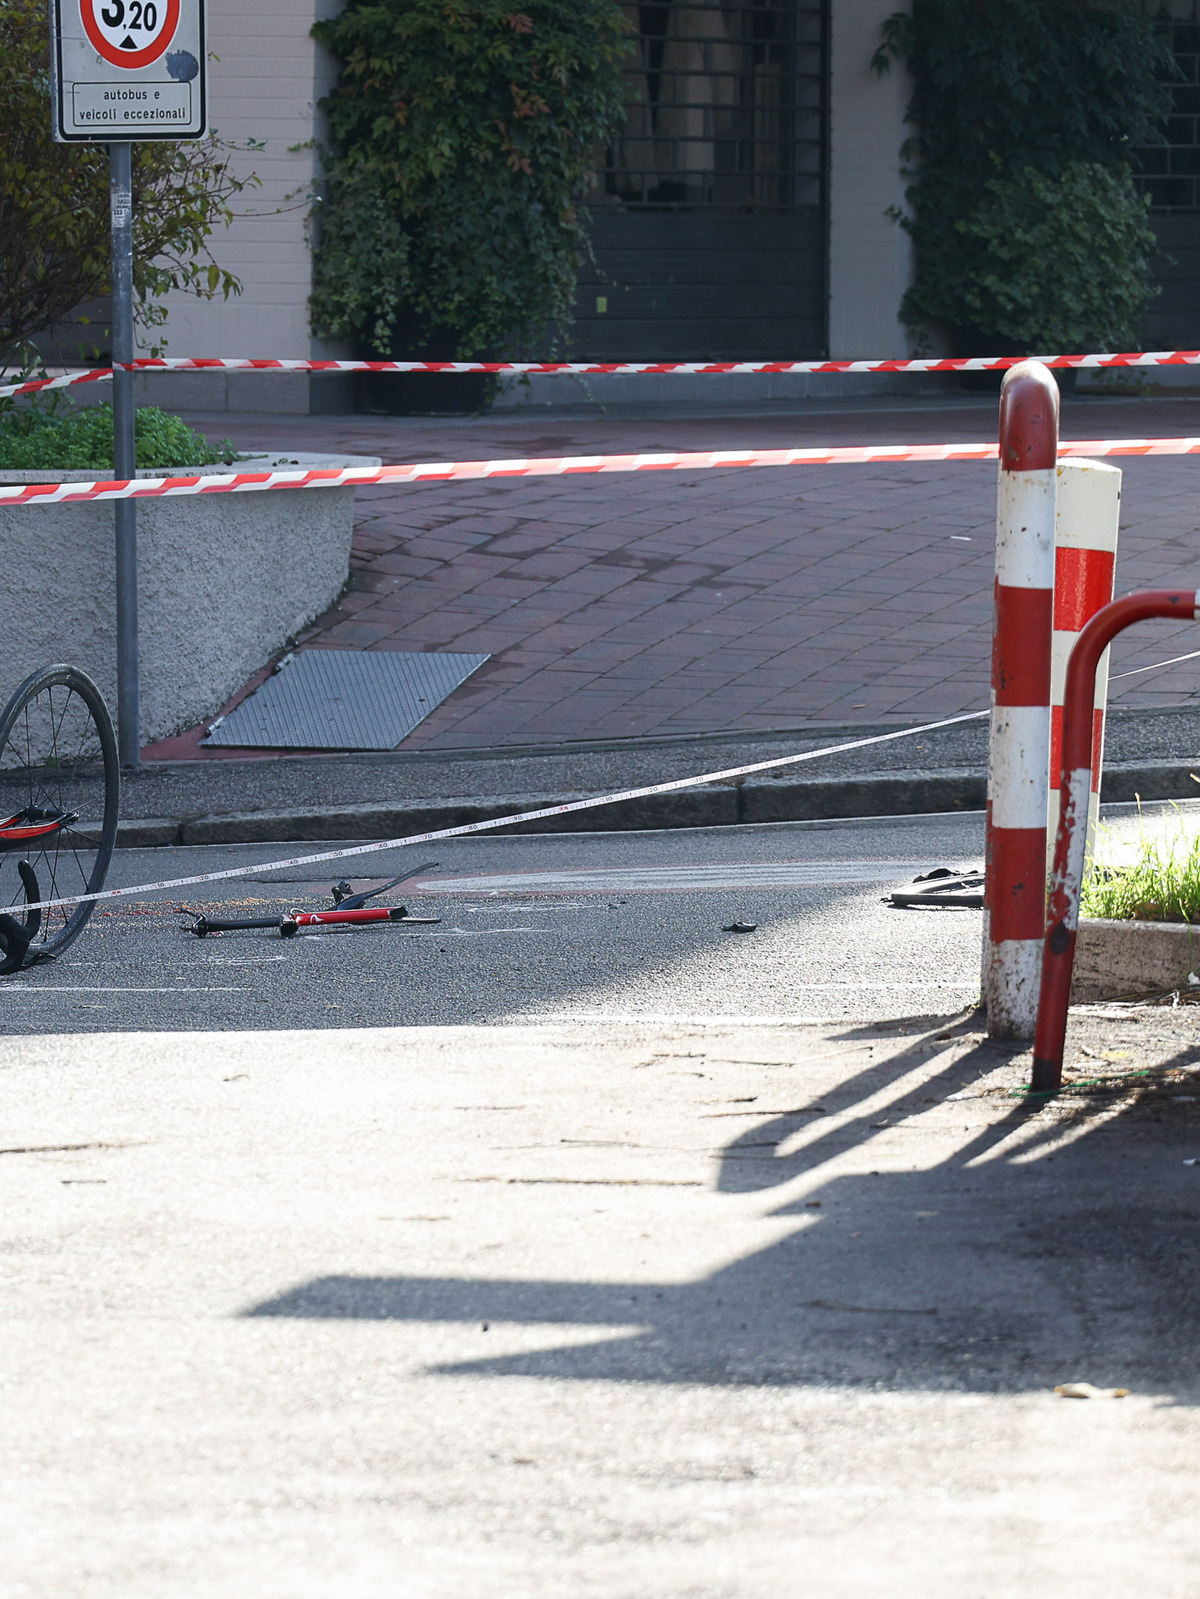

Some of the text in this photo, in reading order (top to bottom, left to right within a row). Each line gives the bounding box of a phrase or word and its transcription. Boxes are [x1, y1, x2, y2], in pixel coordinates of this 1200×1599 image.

[103, 89, 160, 101] autobus e
[79, 107, 186, 120] veicoli eccezionali
